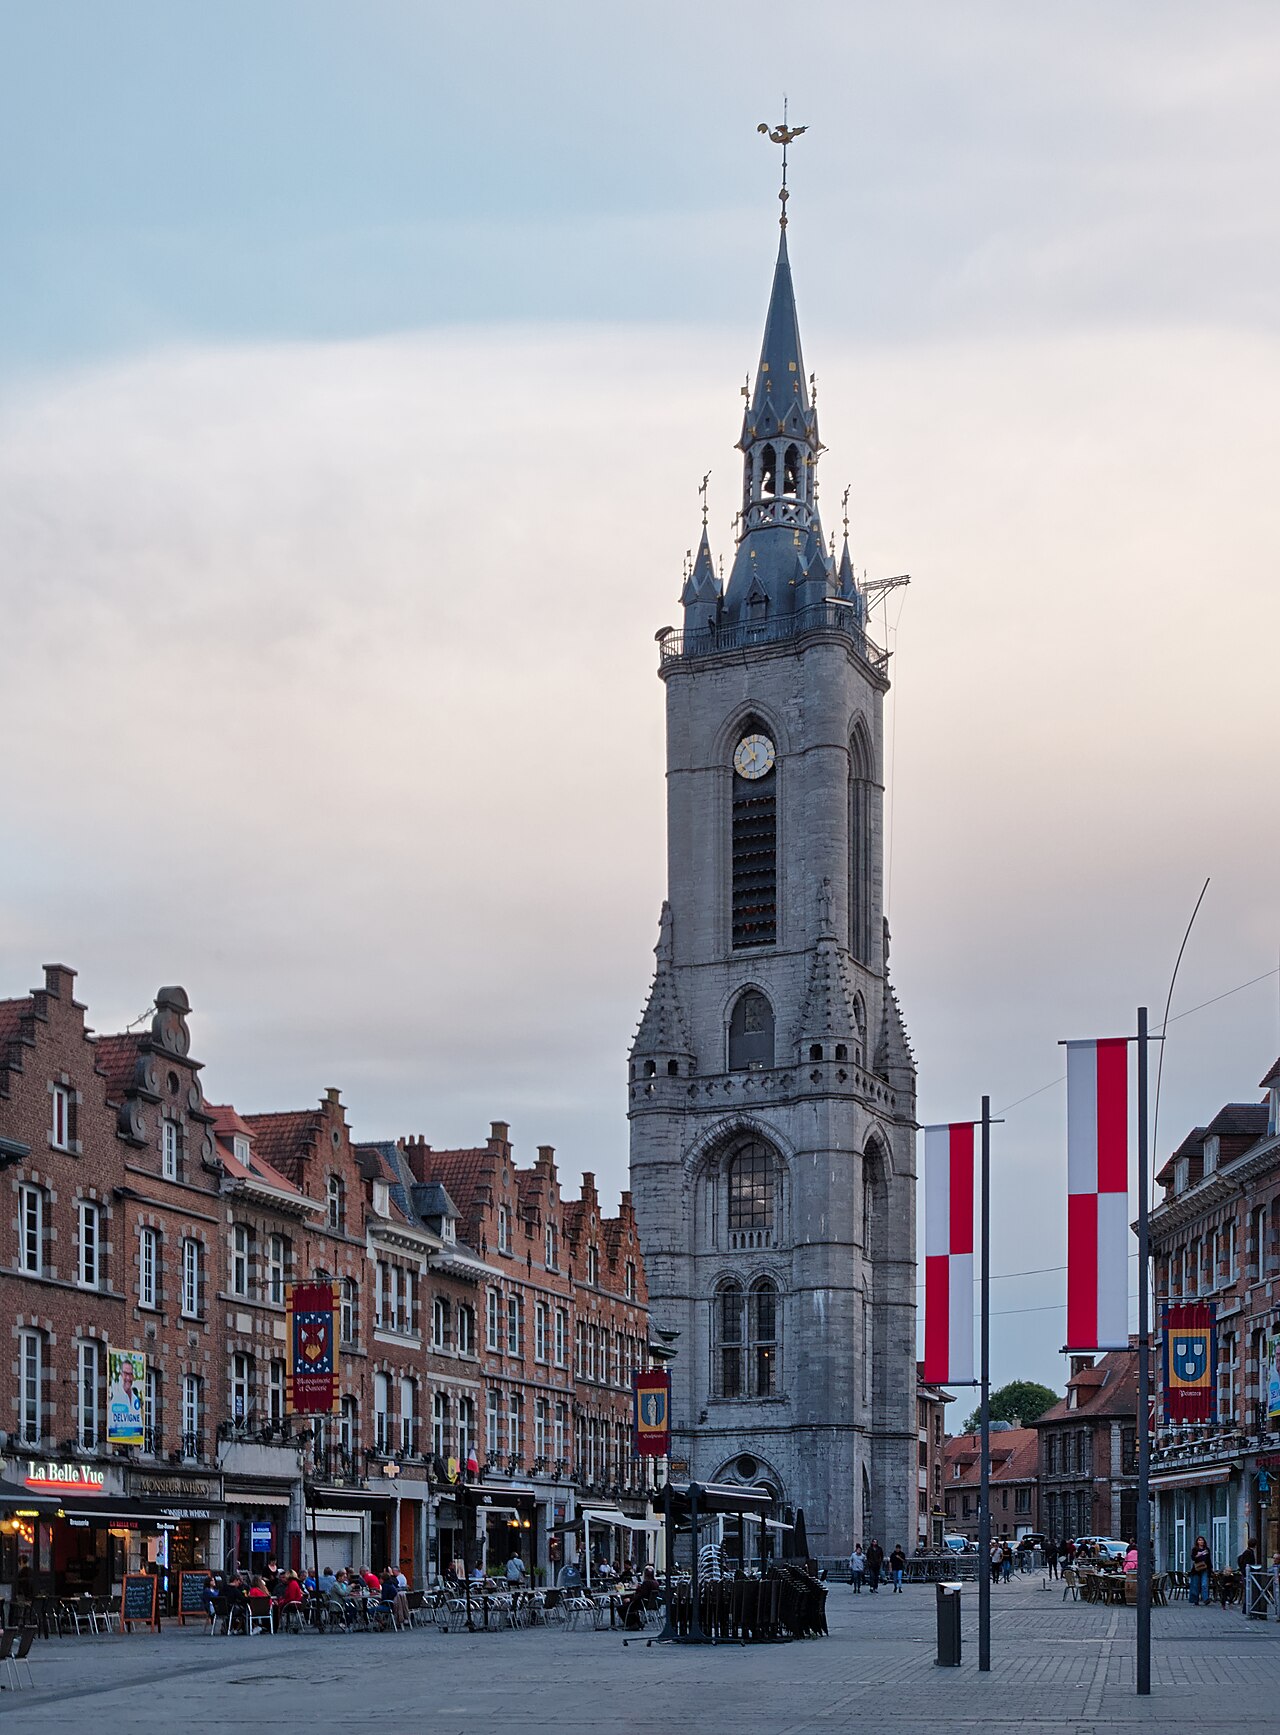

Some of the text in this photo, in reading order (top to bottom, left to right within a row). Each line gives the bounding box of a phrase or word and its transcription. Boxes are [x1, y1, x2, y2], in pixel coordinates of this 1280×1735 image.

[113, 1413, 140, 1422] DELVIGNE
[29, 1461, 104, 1484] La Belle Vue
[142, 1480, 210, 1494] MONSIEUR WHISKY
[189, 1510, 210, 1518] WHISKY
